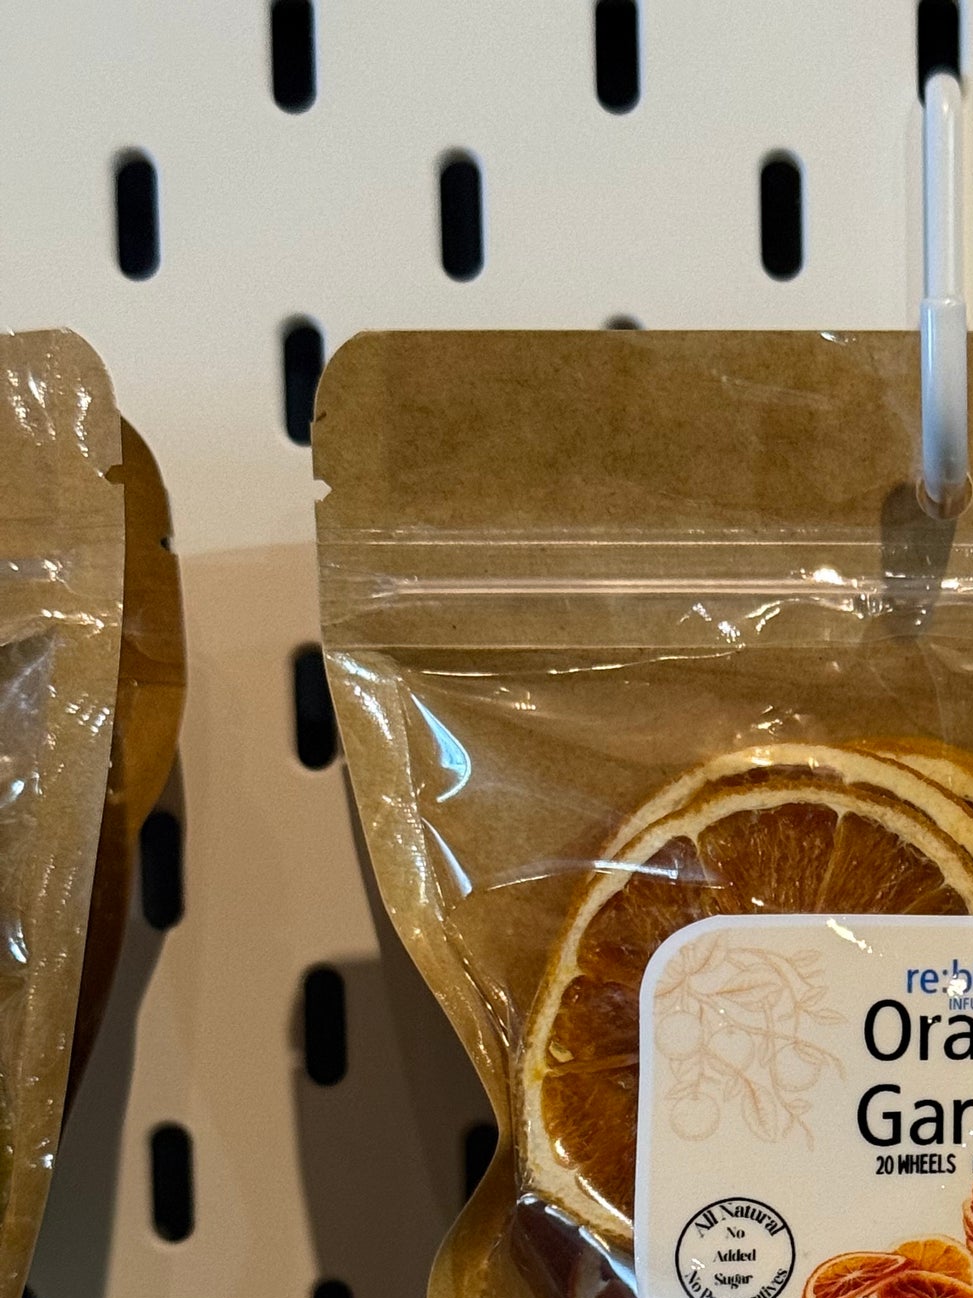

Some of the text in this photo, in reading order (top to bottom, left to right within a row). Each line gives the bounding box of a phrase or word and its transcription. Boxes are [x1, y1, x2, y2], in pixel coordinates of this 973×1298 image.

[876, 1156, 894, 1175] 20
[898, 1154, 956, 1175] WHEELS
[694, 1202, 786, 1238] All Natural
[725, 1226, 746, 1240] No
[713, 1248, 757, 1263] Added
[684, 1269, 702, 1293] No
[713, 1272, 754, 1290] Sugar
